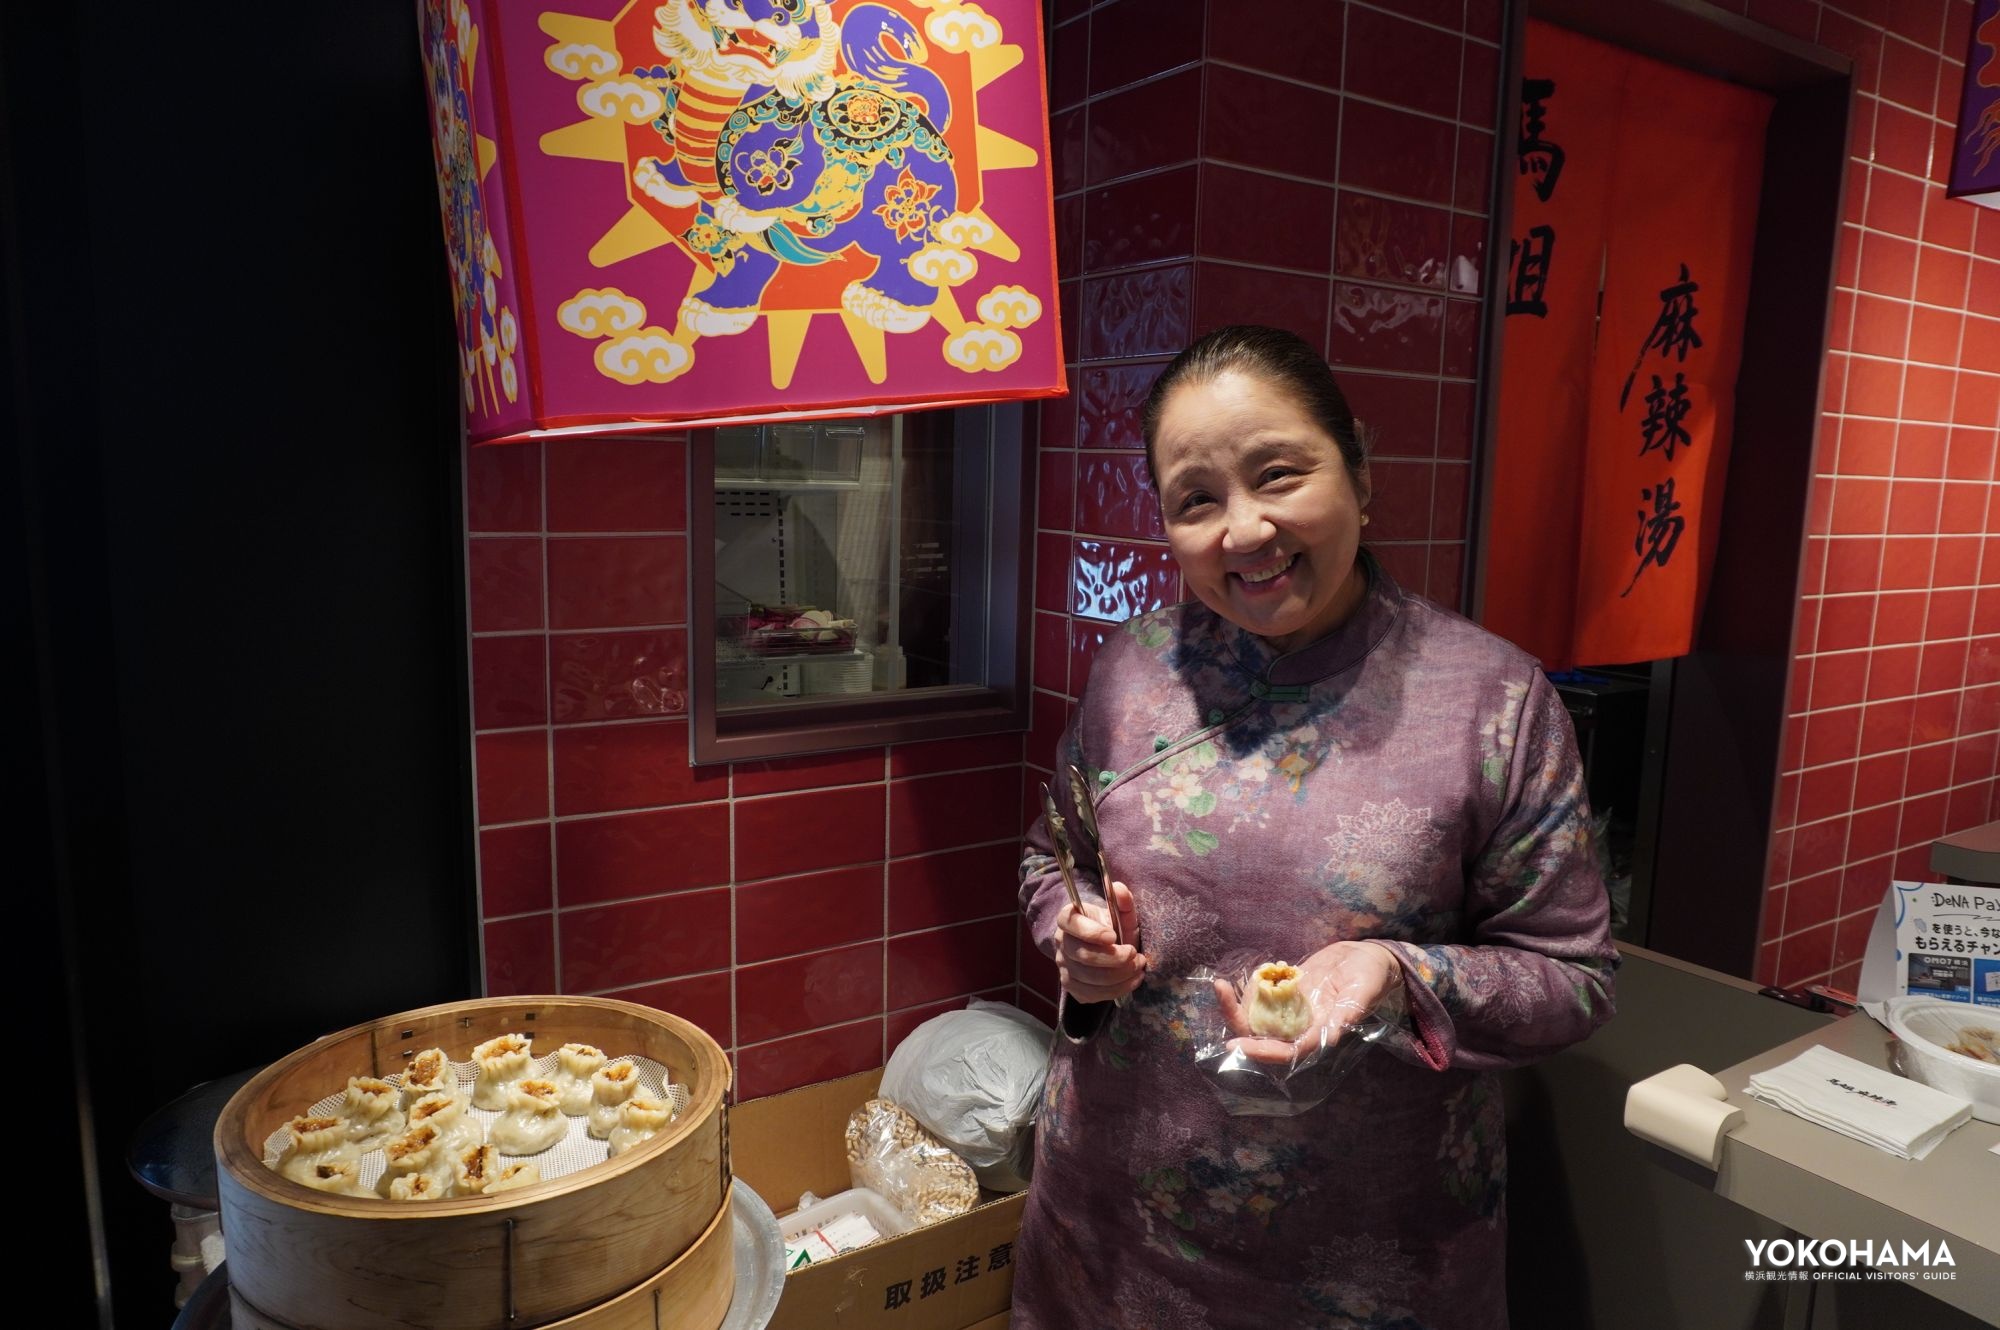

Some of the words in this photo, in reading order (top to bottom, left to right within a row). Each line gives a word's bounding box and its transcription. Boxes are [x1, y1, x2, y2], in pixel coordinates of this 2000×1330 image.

[1619, 261, 1703, 598] 麻辣湯
[1932, 893, 1970, 909] DeNA
[884, 1242, 1015, 1311] 取扱注意
